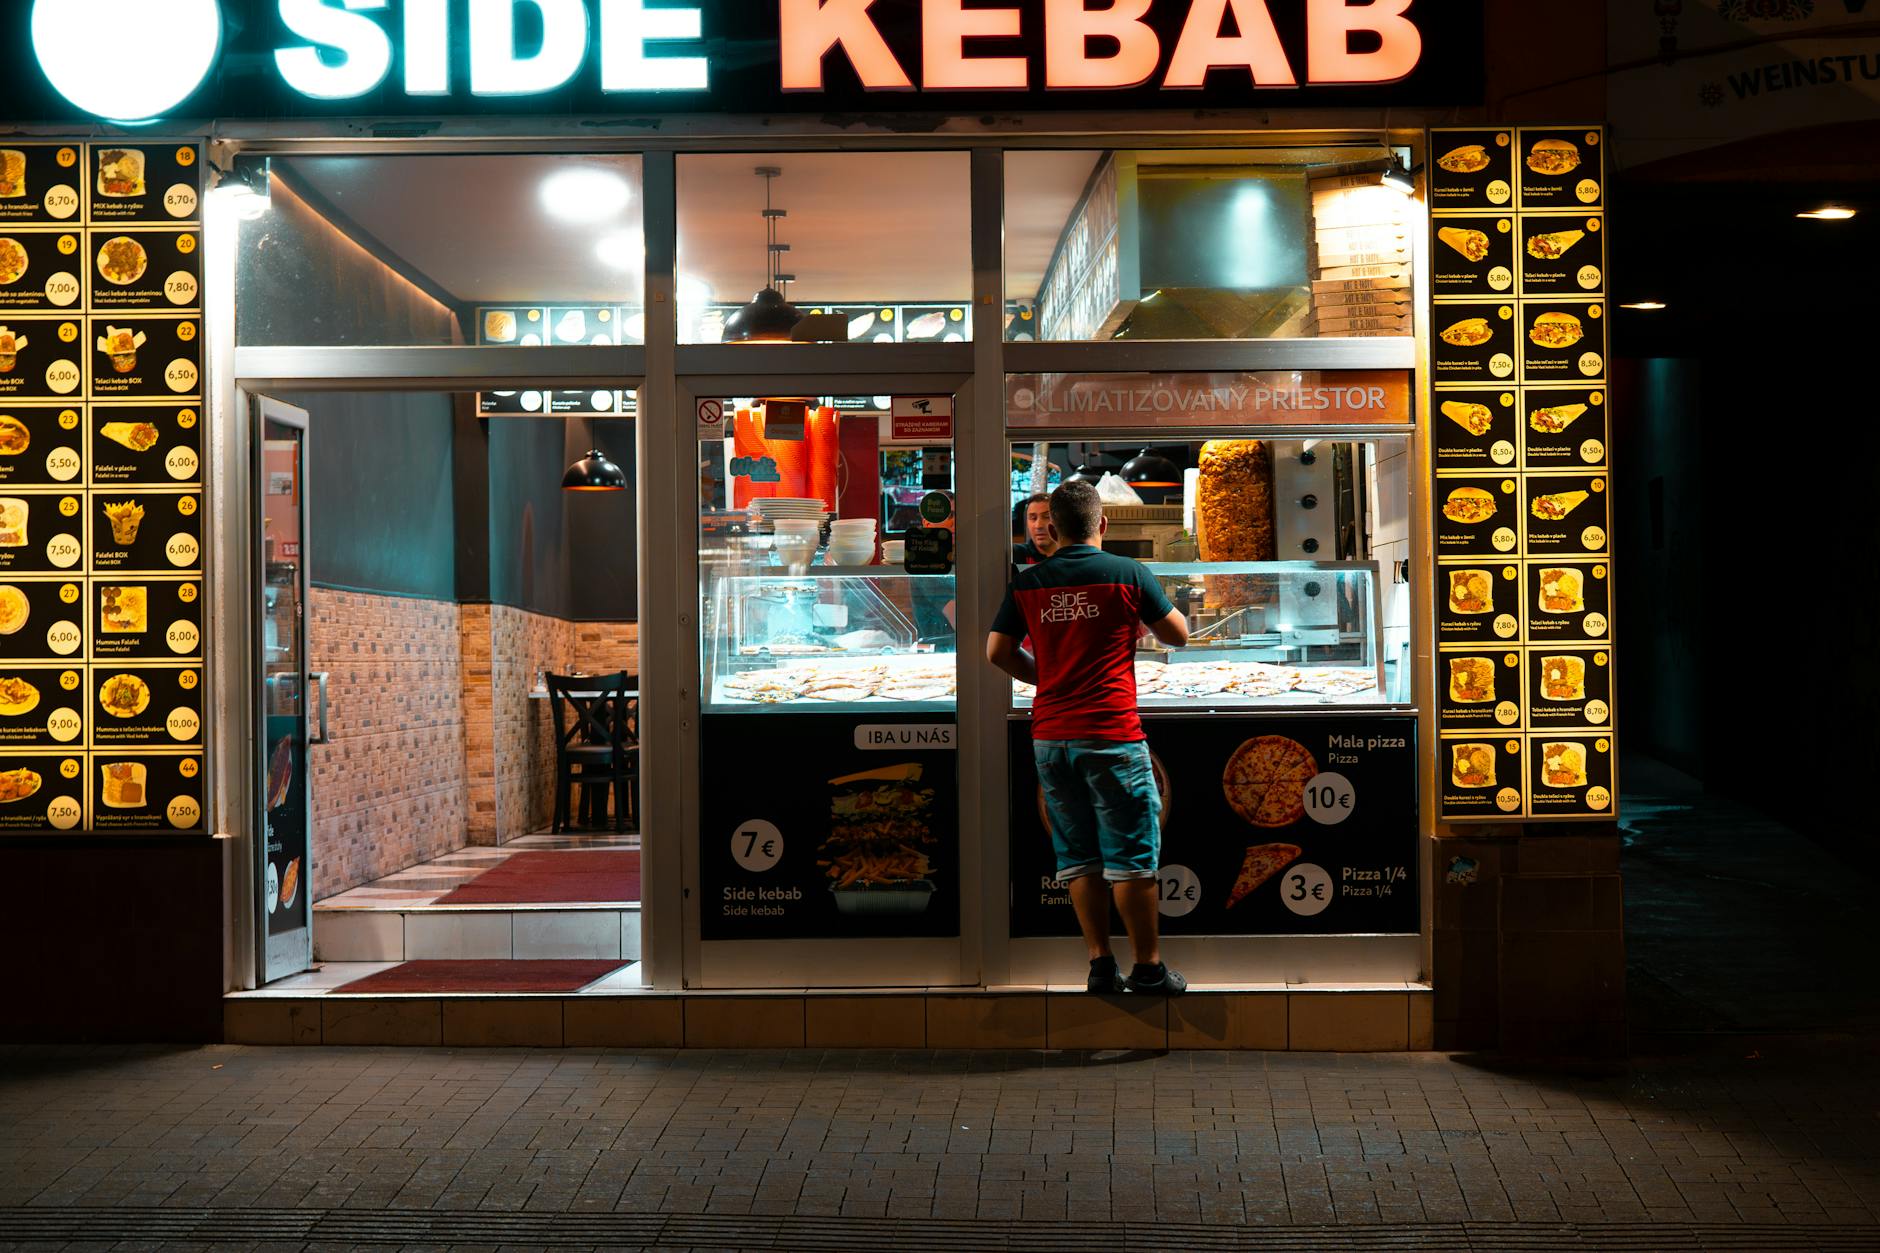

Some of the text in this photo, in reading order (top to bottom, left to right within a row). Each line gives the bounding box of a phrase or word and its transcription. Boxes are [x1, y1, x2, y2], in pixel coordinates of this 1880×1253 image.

[274, 0, 1422, 99] SIDE KEBAB
[62, 152, 72, 161] 17
[179, 152, 191, 161] 18
[62, 241, 73, 249] 19
[180, 239, 192, 248] 20
[62, 328, 73, 337] 21
[180, 327, 192, 336] 22
[1255, 386, 1386, 411] PRIESTOR
[62, 416, 74, 425] 23
[181, 415, 193, 424] 24
[63, 502, 75, 511] 25
[181, 501, 194, 510] 26
[63, 589, 75, 598] 27
[182, 588, 194, 597] 28
[1041, 604, 1100, 623] KEBAB
[63, 676, 76, 685] 29
[182, 676, 195, 684] 30
[868, 728, 950, 744] IBA U NÁS
[1328, 734, 1406, 751] Mala pizza
[1328, 752, 1359, 764] Pizza
[63, 764, 76, 773] 42
[182, 764, 196, 773] 44
[1342, 866, 1407, 883] Pizza 1/4
[723, 886, 803, 900] Side kebab
[1342, 884, 1393, 899] Pizza 1/4
[722, 904, 785, 916] Side kebab
